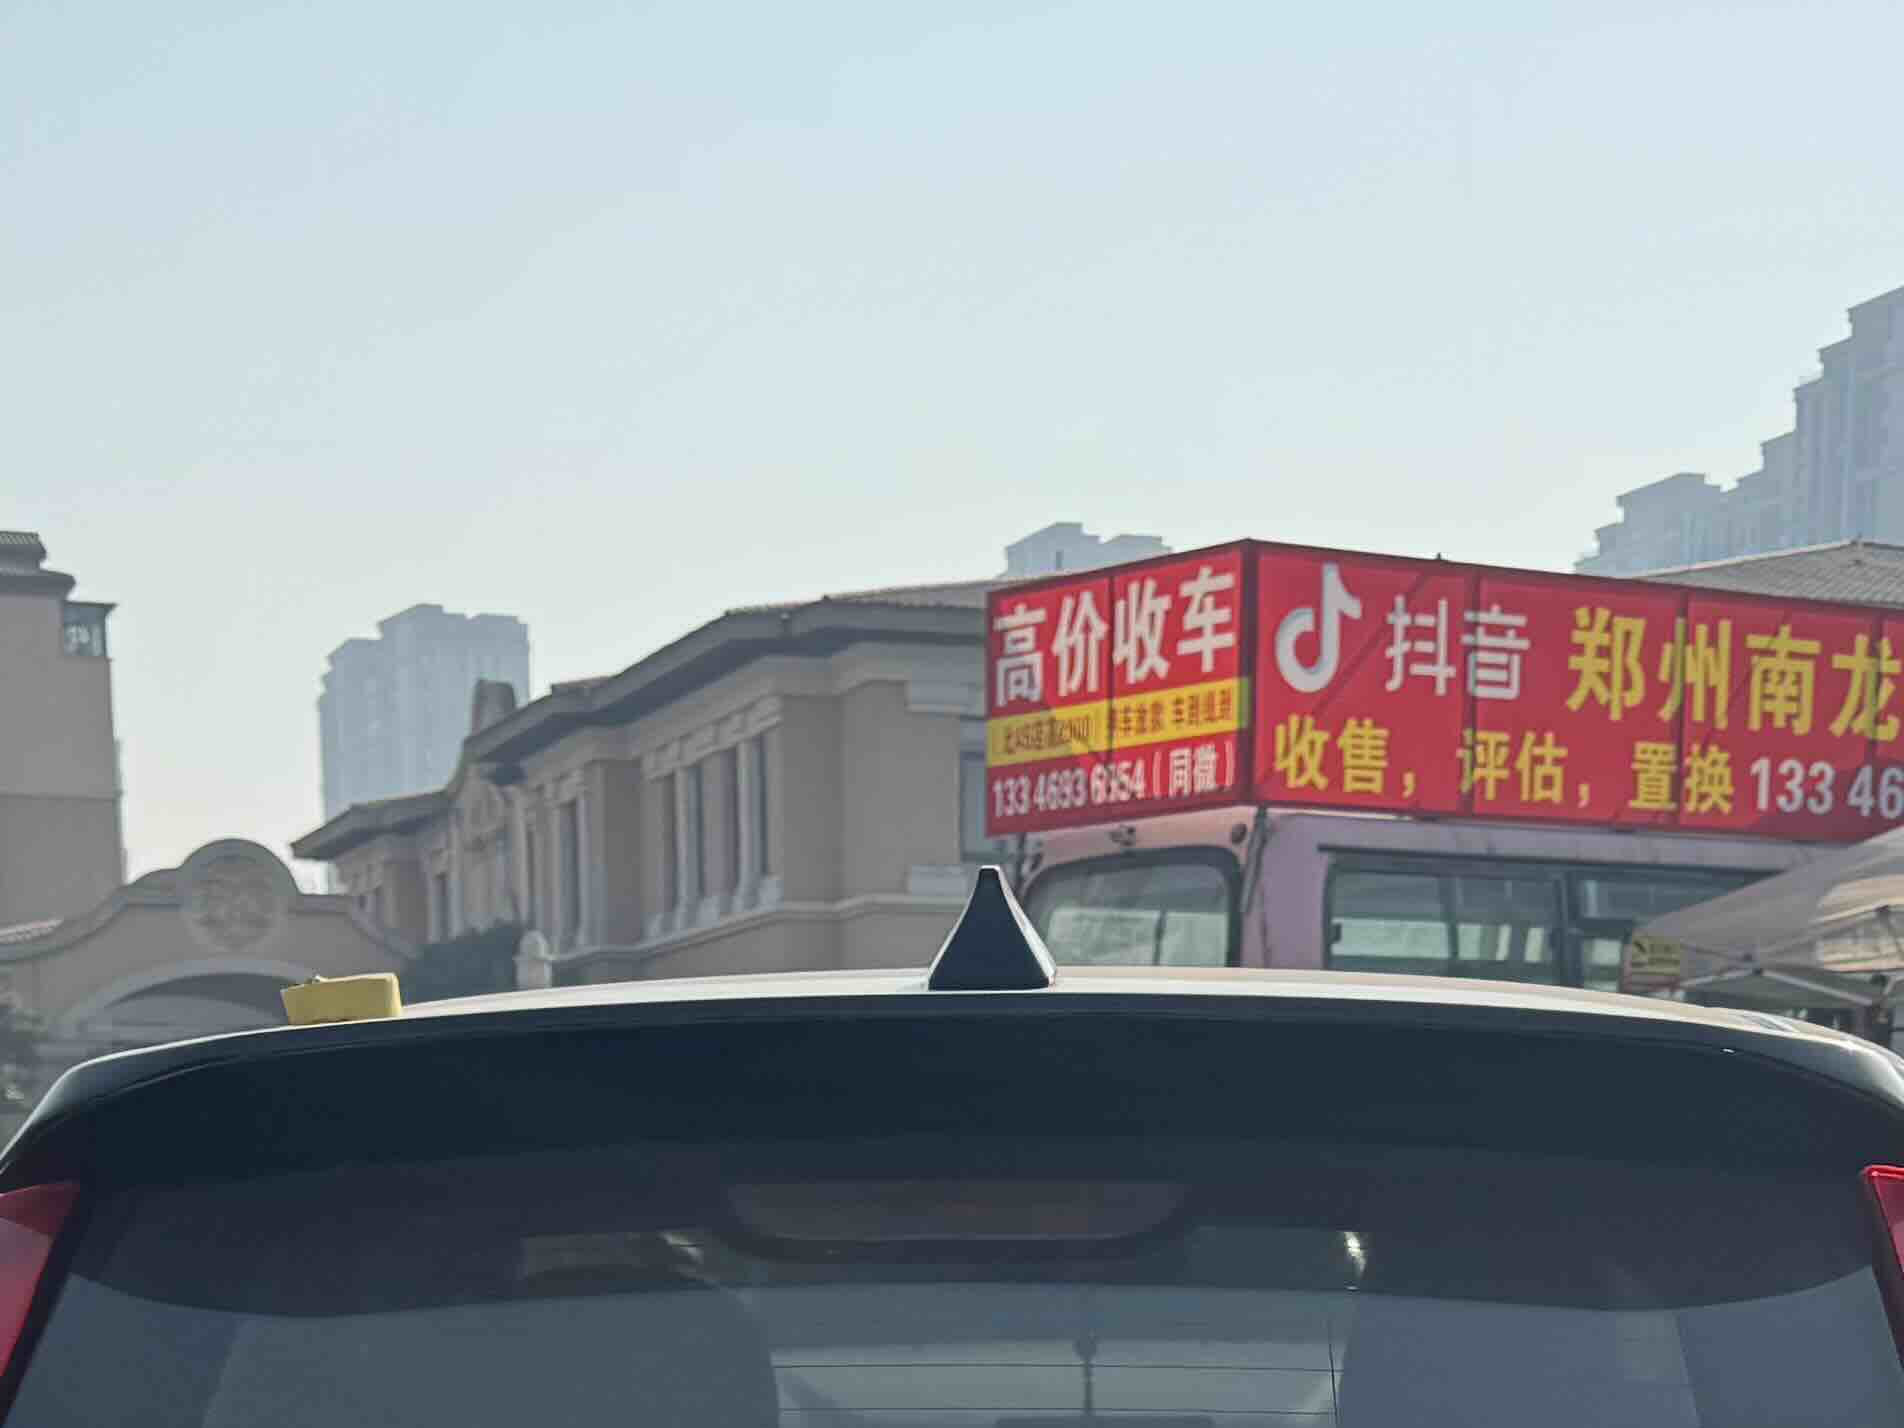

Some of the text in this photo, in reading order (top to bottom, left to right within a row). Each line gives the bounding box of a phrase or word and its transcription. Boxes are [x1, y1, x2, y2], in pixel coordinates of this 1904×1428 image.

[992, 566, 1238, 707] 高价收车
[1384, 595, 1531, 699] 抖音
[1749, 757, 1837, 817] 133
